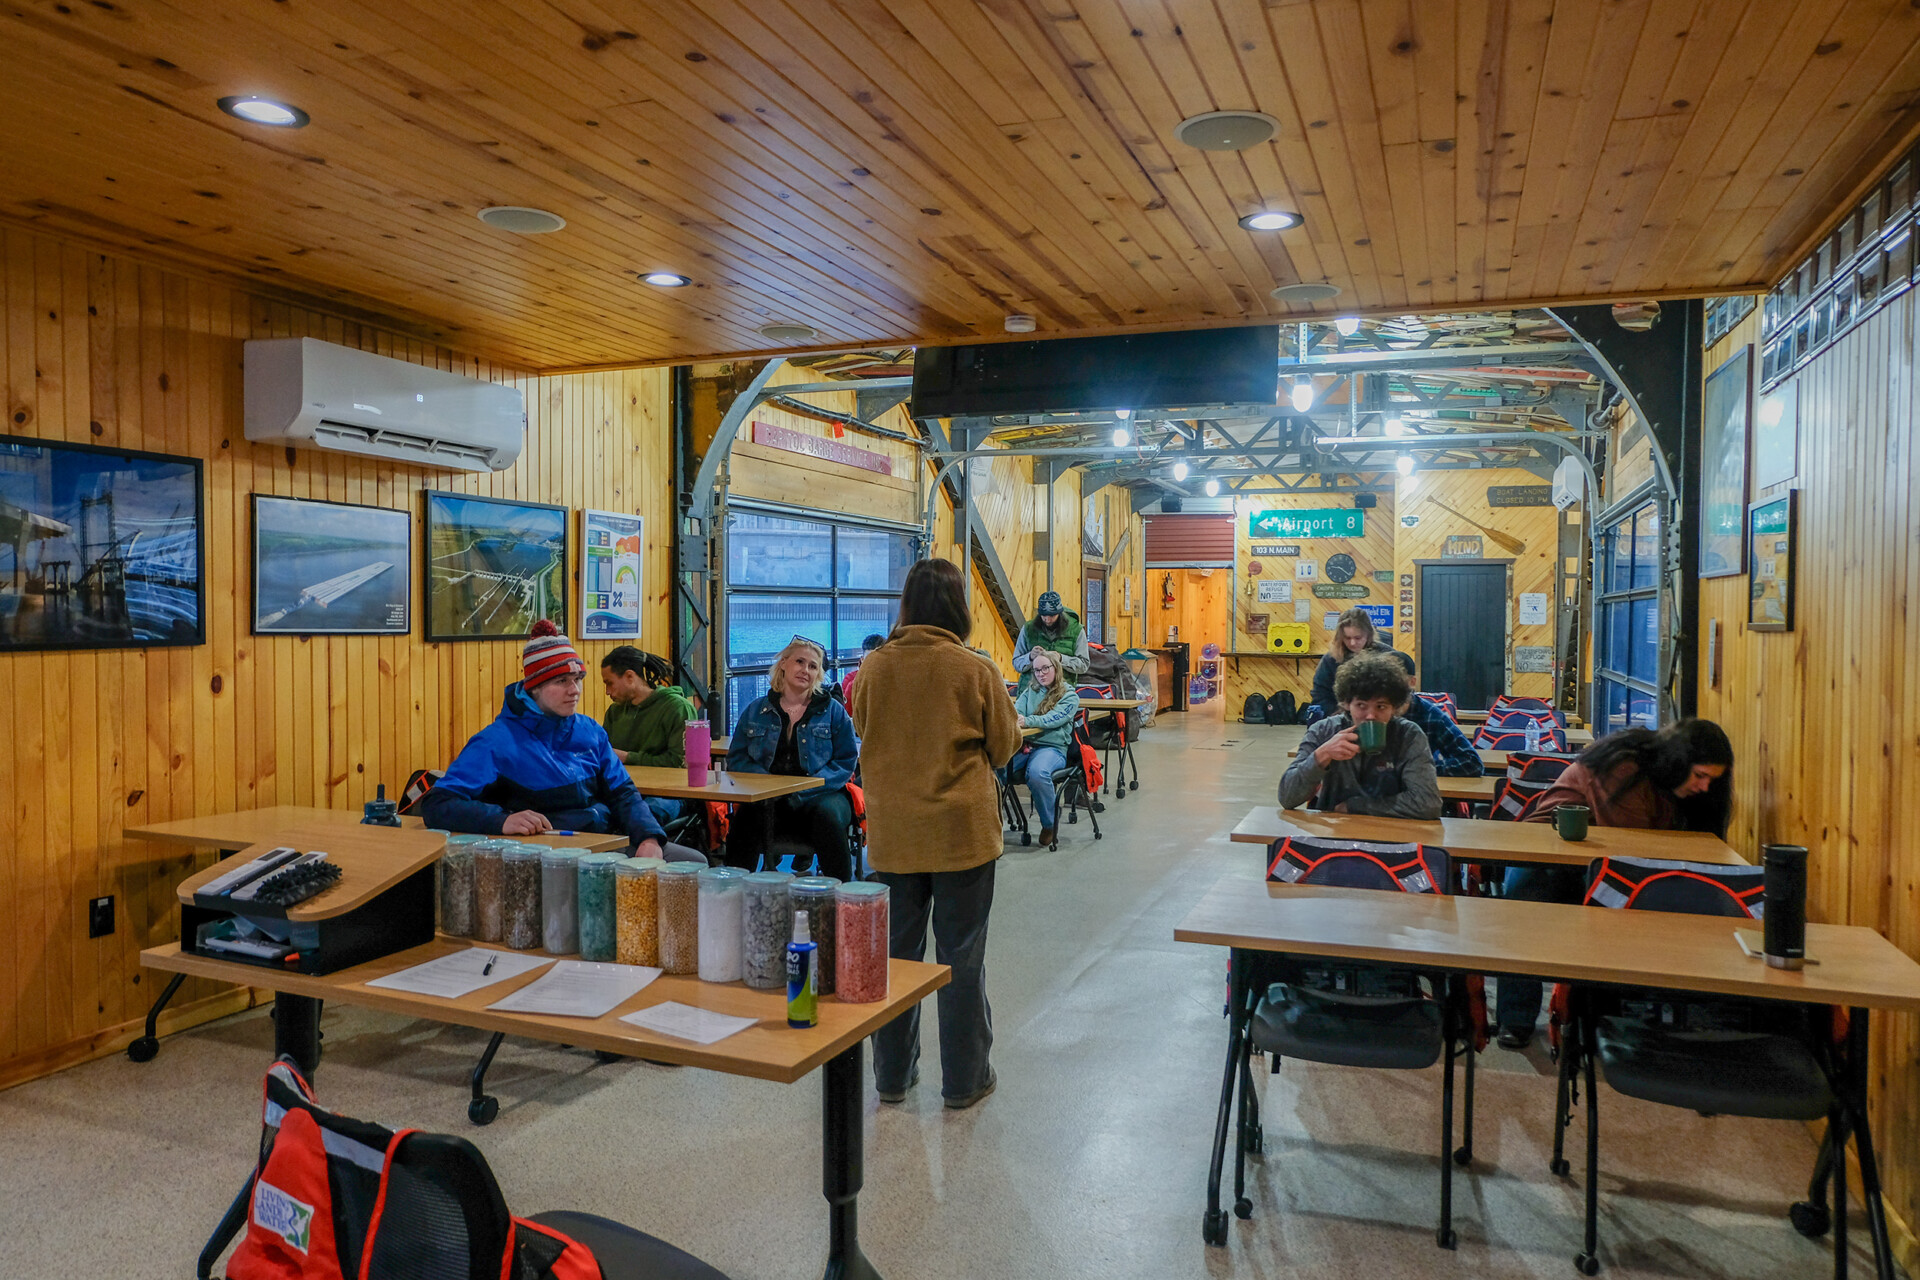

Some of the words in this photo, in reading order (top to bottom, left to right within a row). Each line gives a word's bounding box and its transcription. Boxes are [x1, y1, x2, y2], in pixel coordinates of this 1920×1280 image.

[807, 438, 834, 461] BARGE
[1496, 488, 1514, 496] BOAT
[1496, 496, 1524, 504] CLOSED
[1282, 516, 1334, 534] Airport
[1346, 516, 1356, 529] 8
[1256, 546, 1268, 554] 103
[1260, 592, 1272, 600] NO
[1380, 608, 1391, 616] Elk
[1516, 662, 1529, 671] NO
